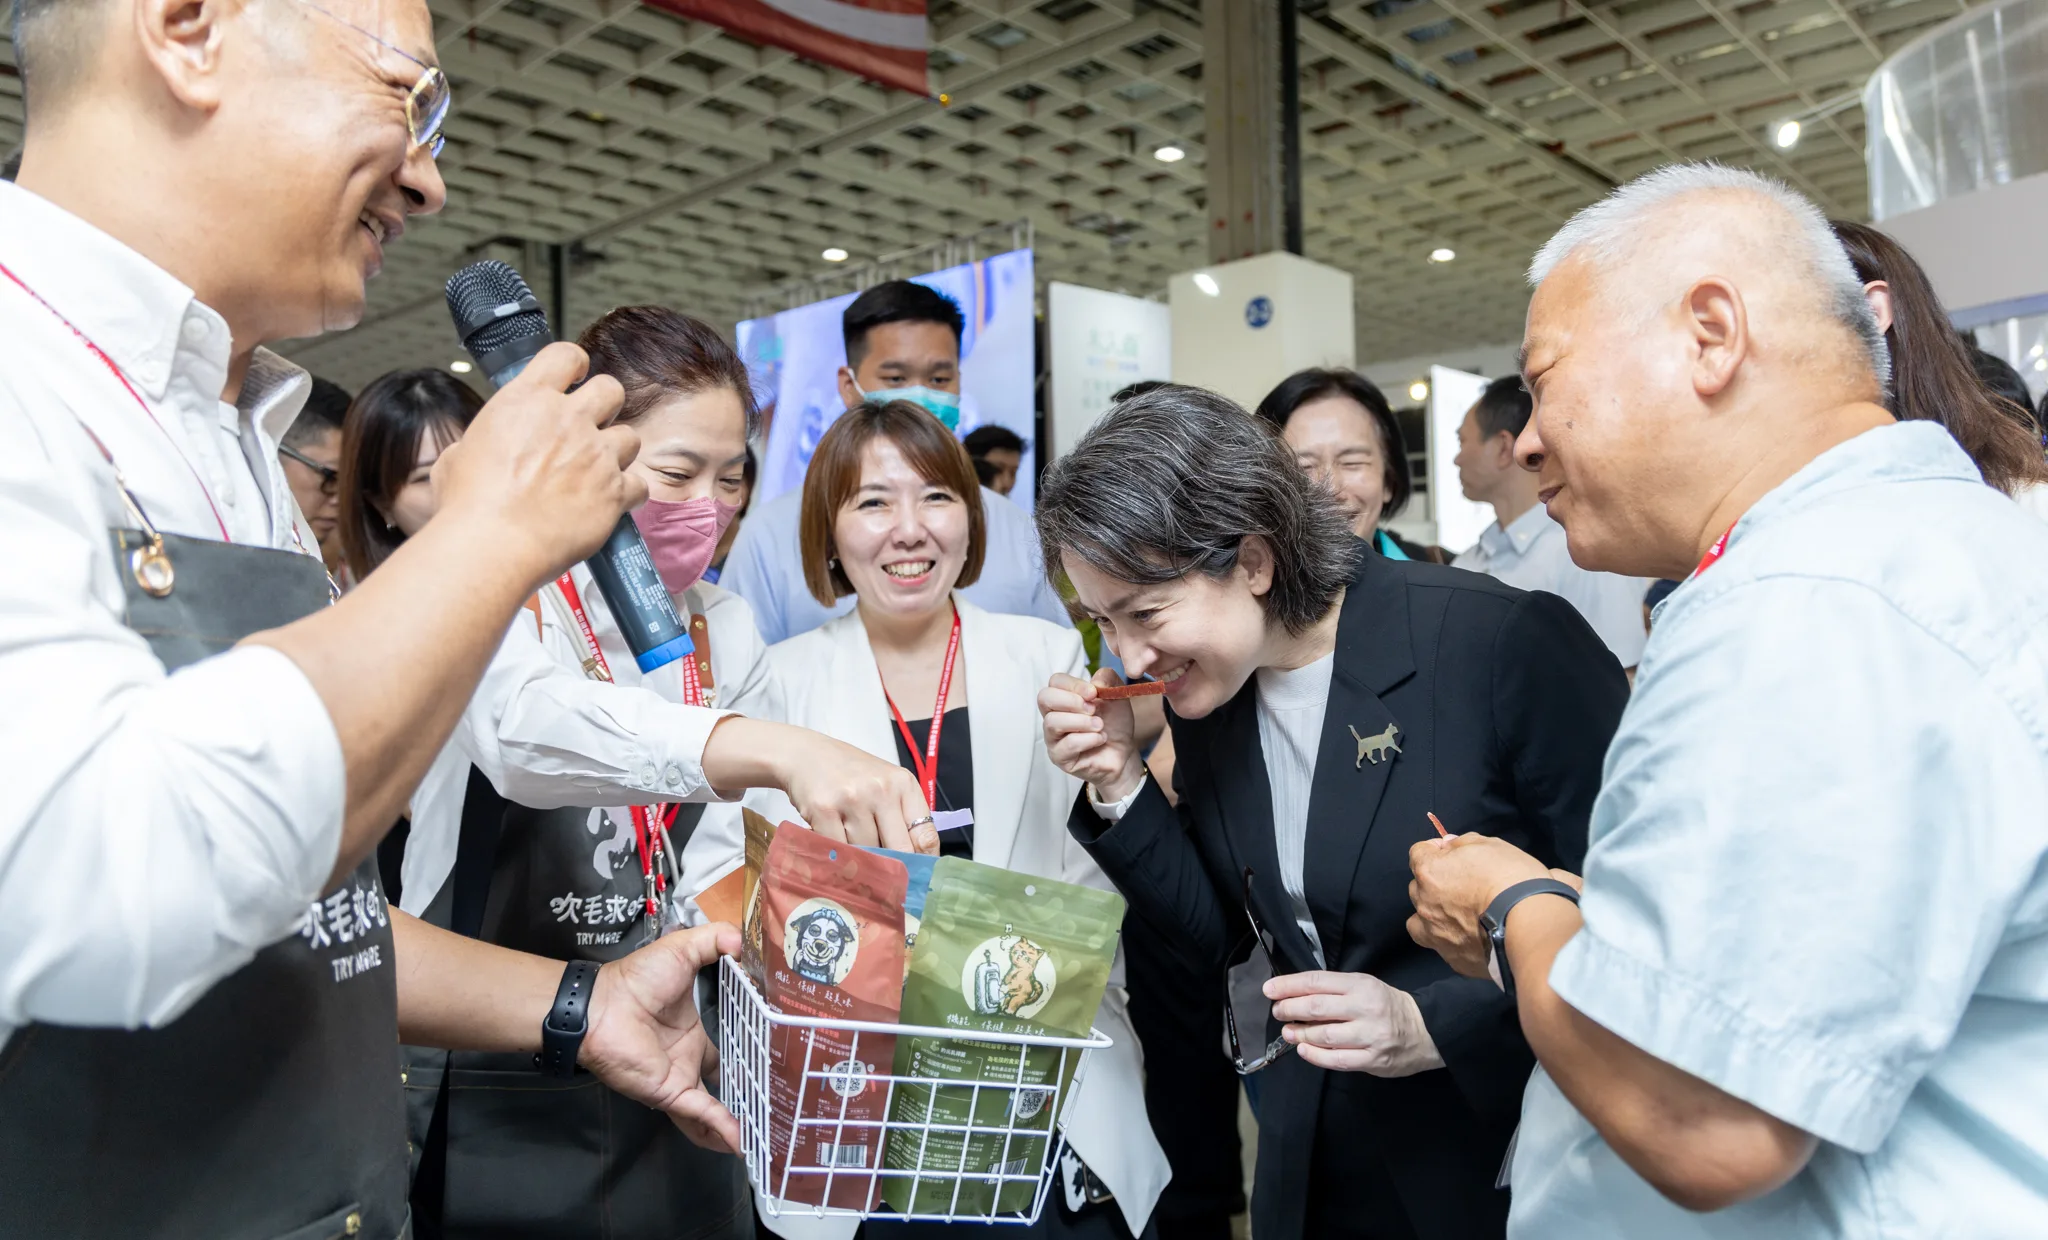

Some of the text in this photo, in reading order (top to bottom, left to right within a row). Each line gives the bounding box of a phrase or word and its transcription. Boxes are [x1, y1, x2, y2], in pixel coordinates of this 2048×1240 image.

[302, 879, 387, 950] 吹毛求吃
[576, 930, 623, 946] TRY MORE
[331, 944, 382, 983] TRY MORE
